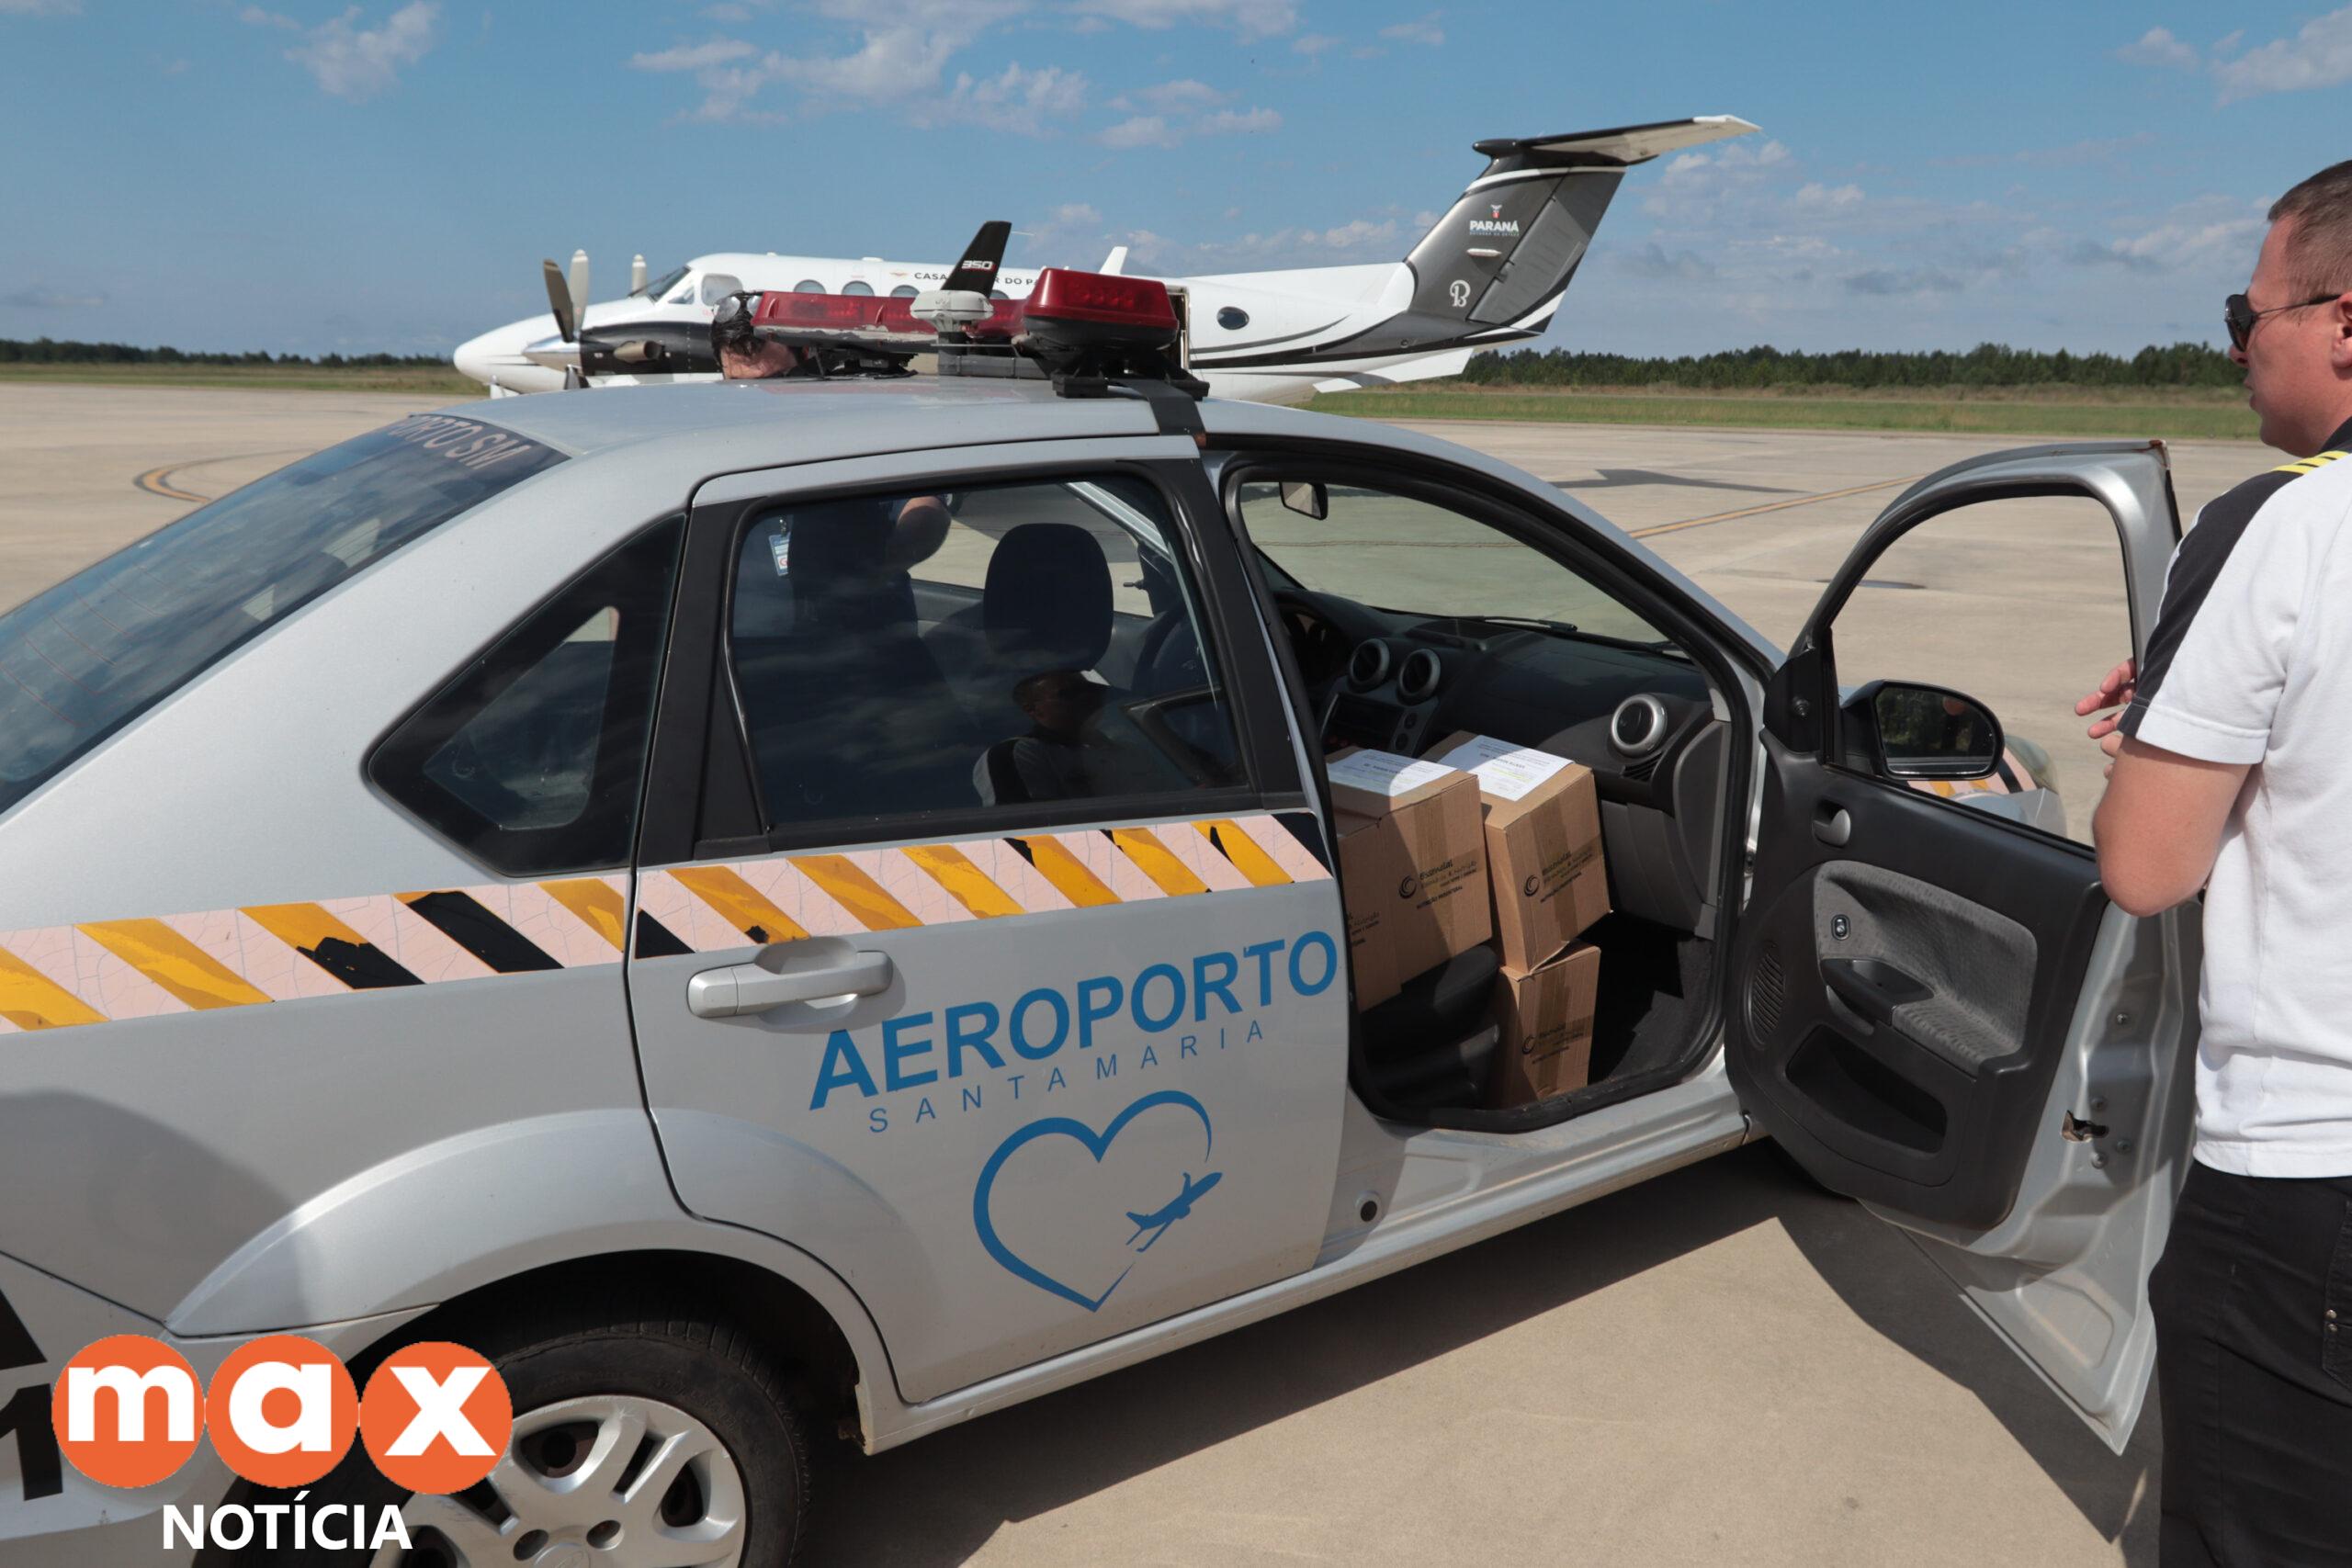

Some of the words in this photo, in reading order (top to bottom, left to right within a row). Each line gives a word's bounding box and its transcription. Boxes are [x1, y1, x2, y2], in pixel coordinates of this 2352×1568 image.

[1469, 220, 1520, 232] PARANÁ
[961, 260, 993, 270] 350
[914, 271, 948, 281] CASA
[1004, 276, 1023, 285] DO
[808, 931, 1338, 1111] AEROPORTO
[868, 1066, 1067, 1134] SANTA
[1096, 1020, 1263, 1079] MARIA
